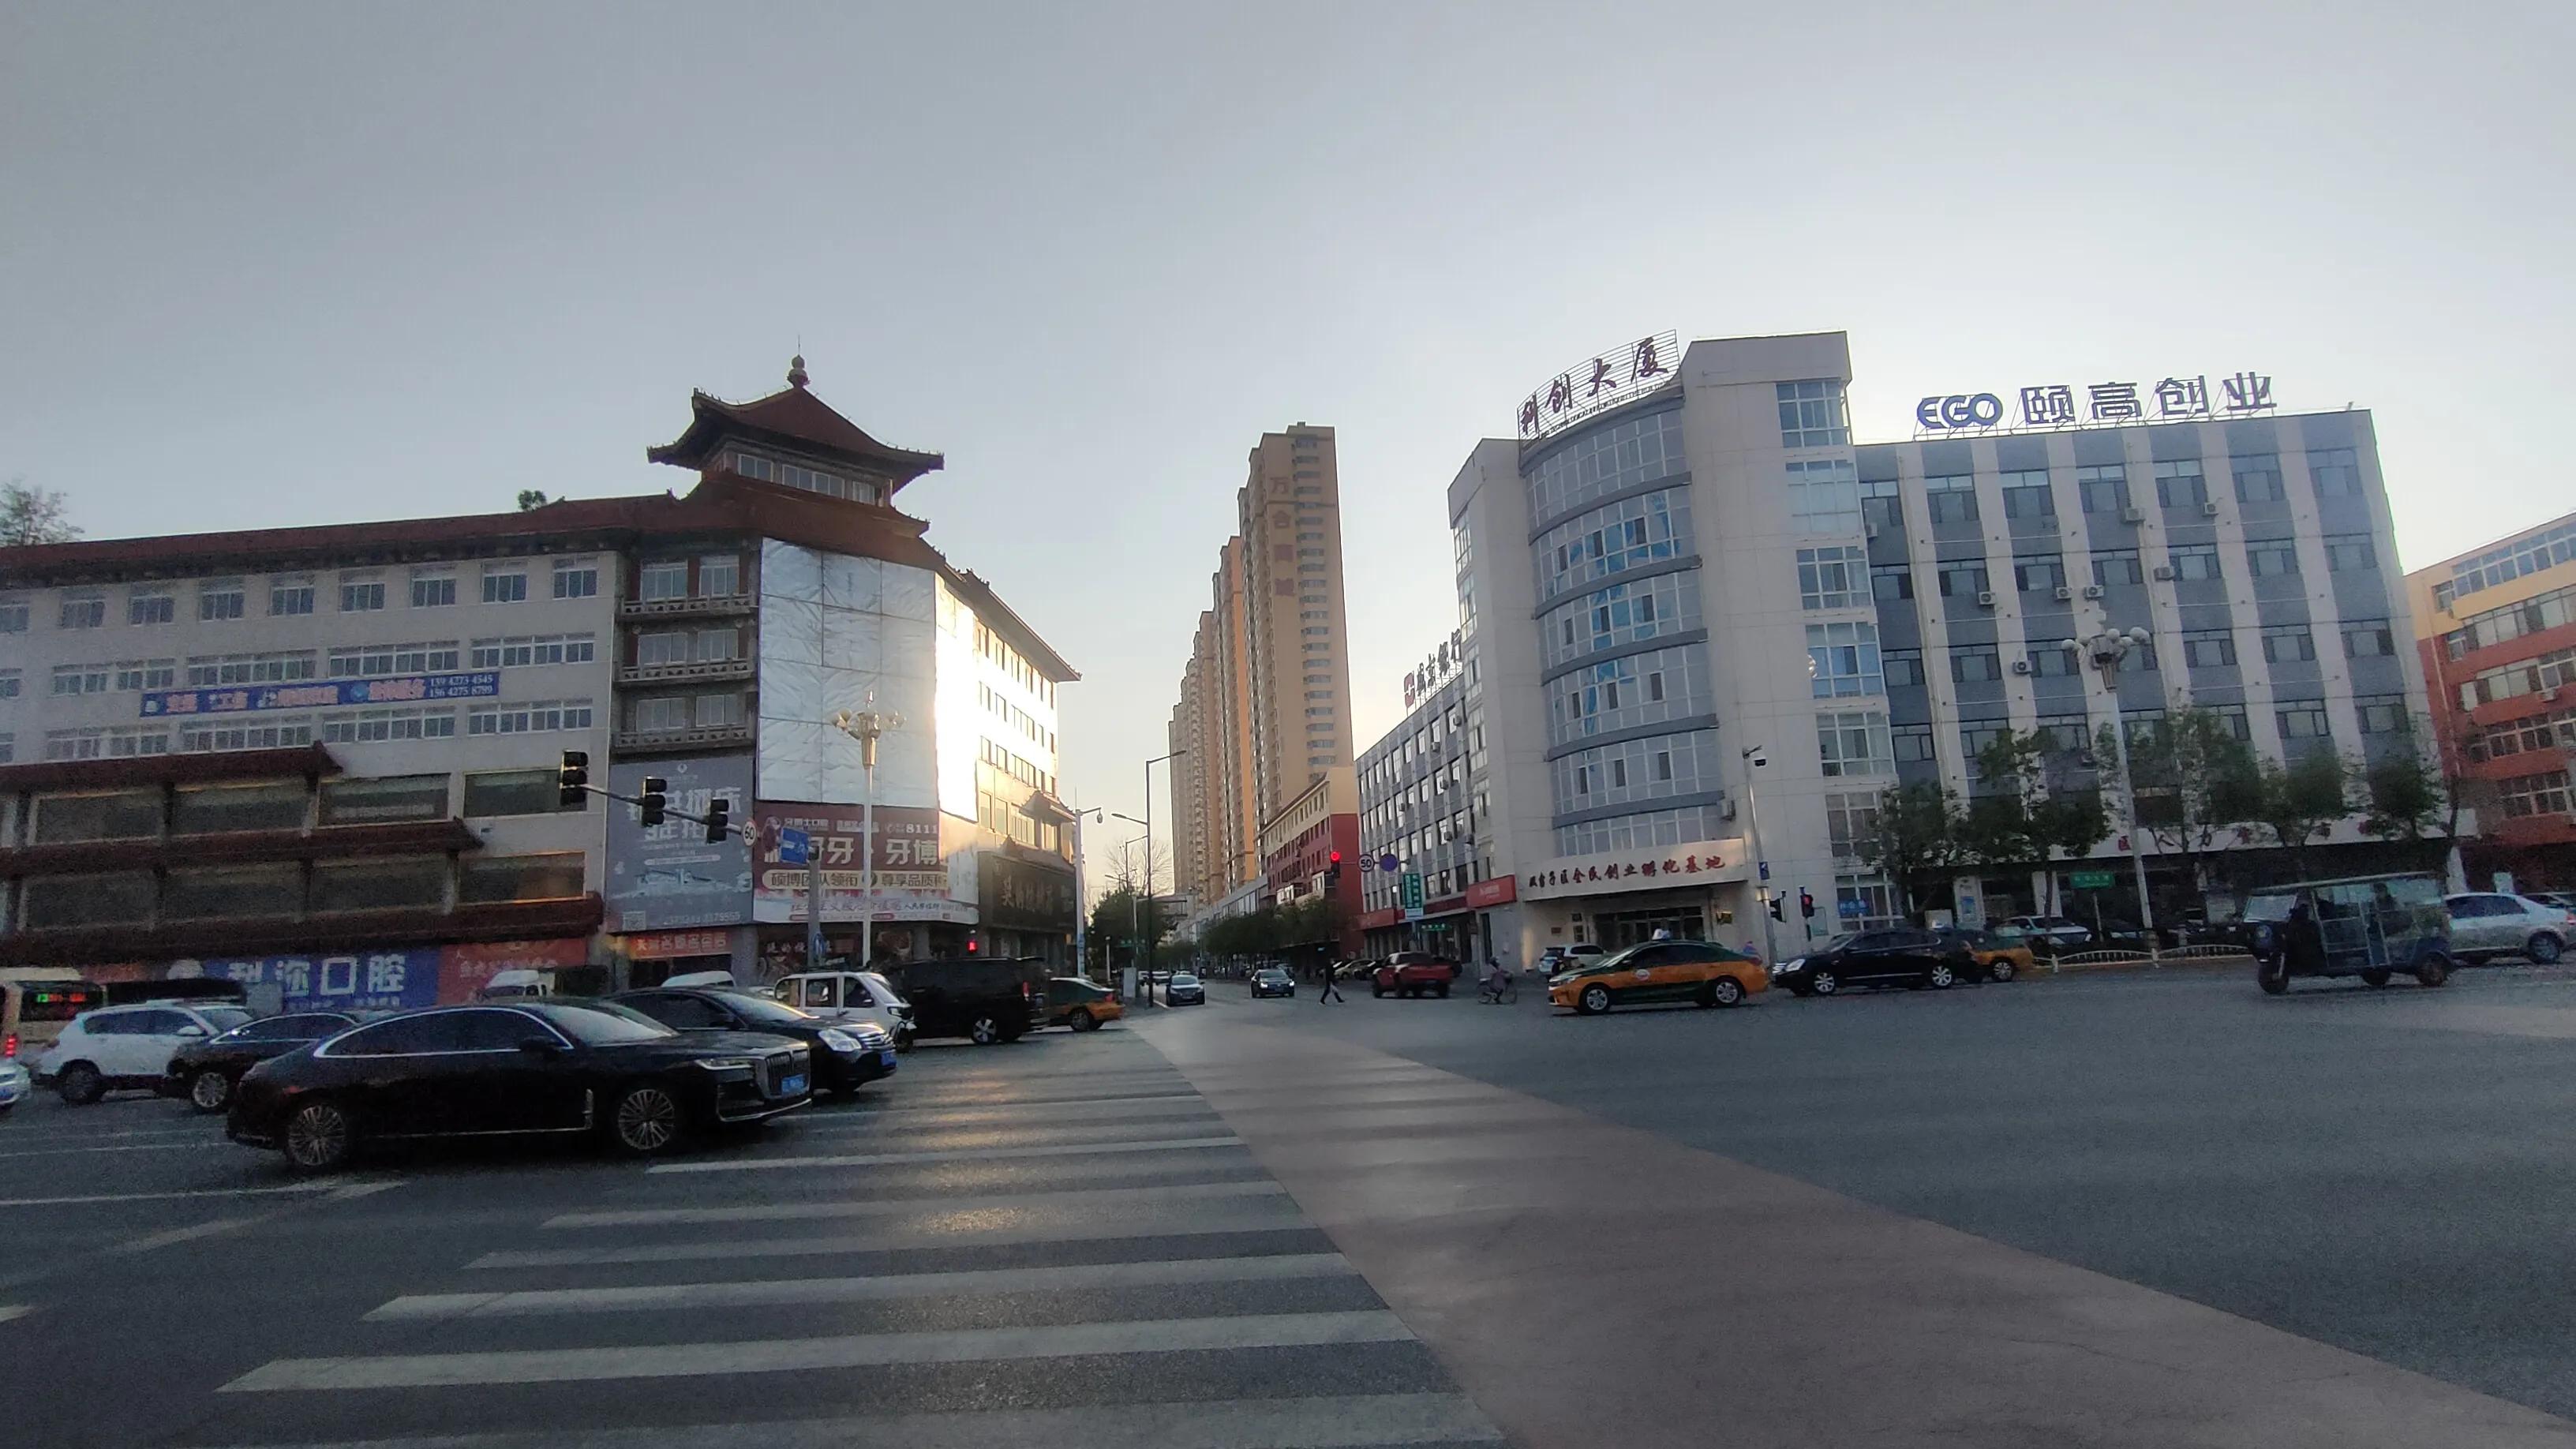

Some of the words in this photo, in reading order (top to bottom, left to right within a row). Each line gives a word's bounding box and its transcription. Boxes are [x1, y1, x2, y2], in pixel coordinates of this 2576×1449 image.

[1520, 336, 1669, 435] 科创大厦
[2020, 371, 2278, 425] 颐高创业
[744, 826, 754, 840] 60
[1360, 859, 1372, 868] 50
